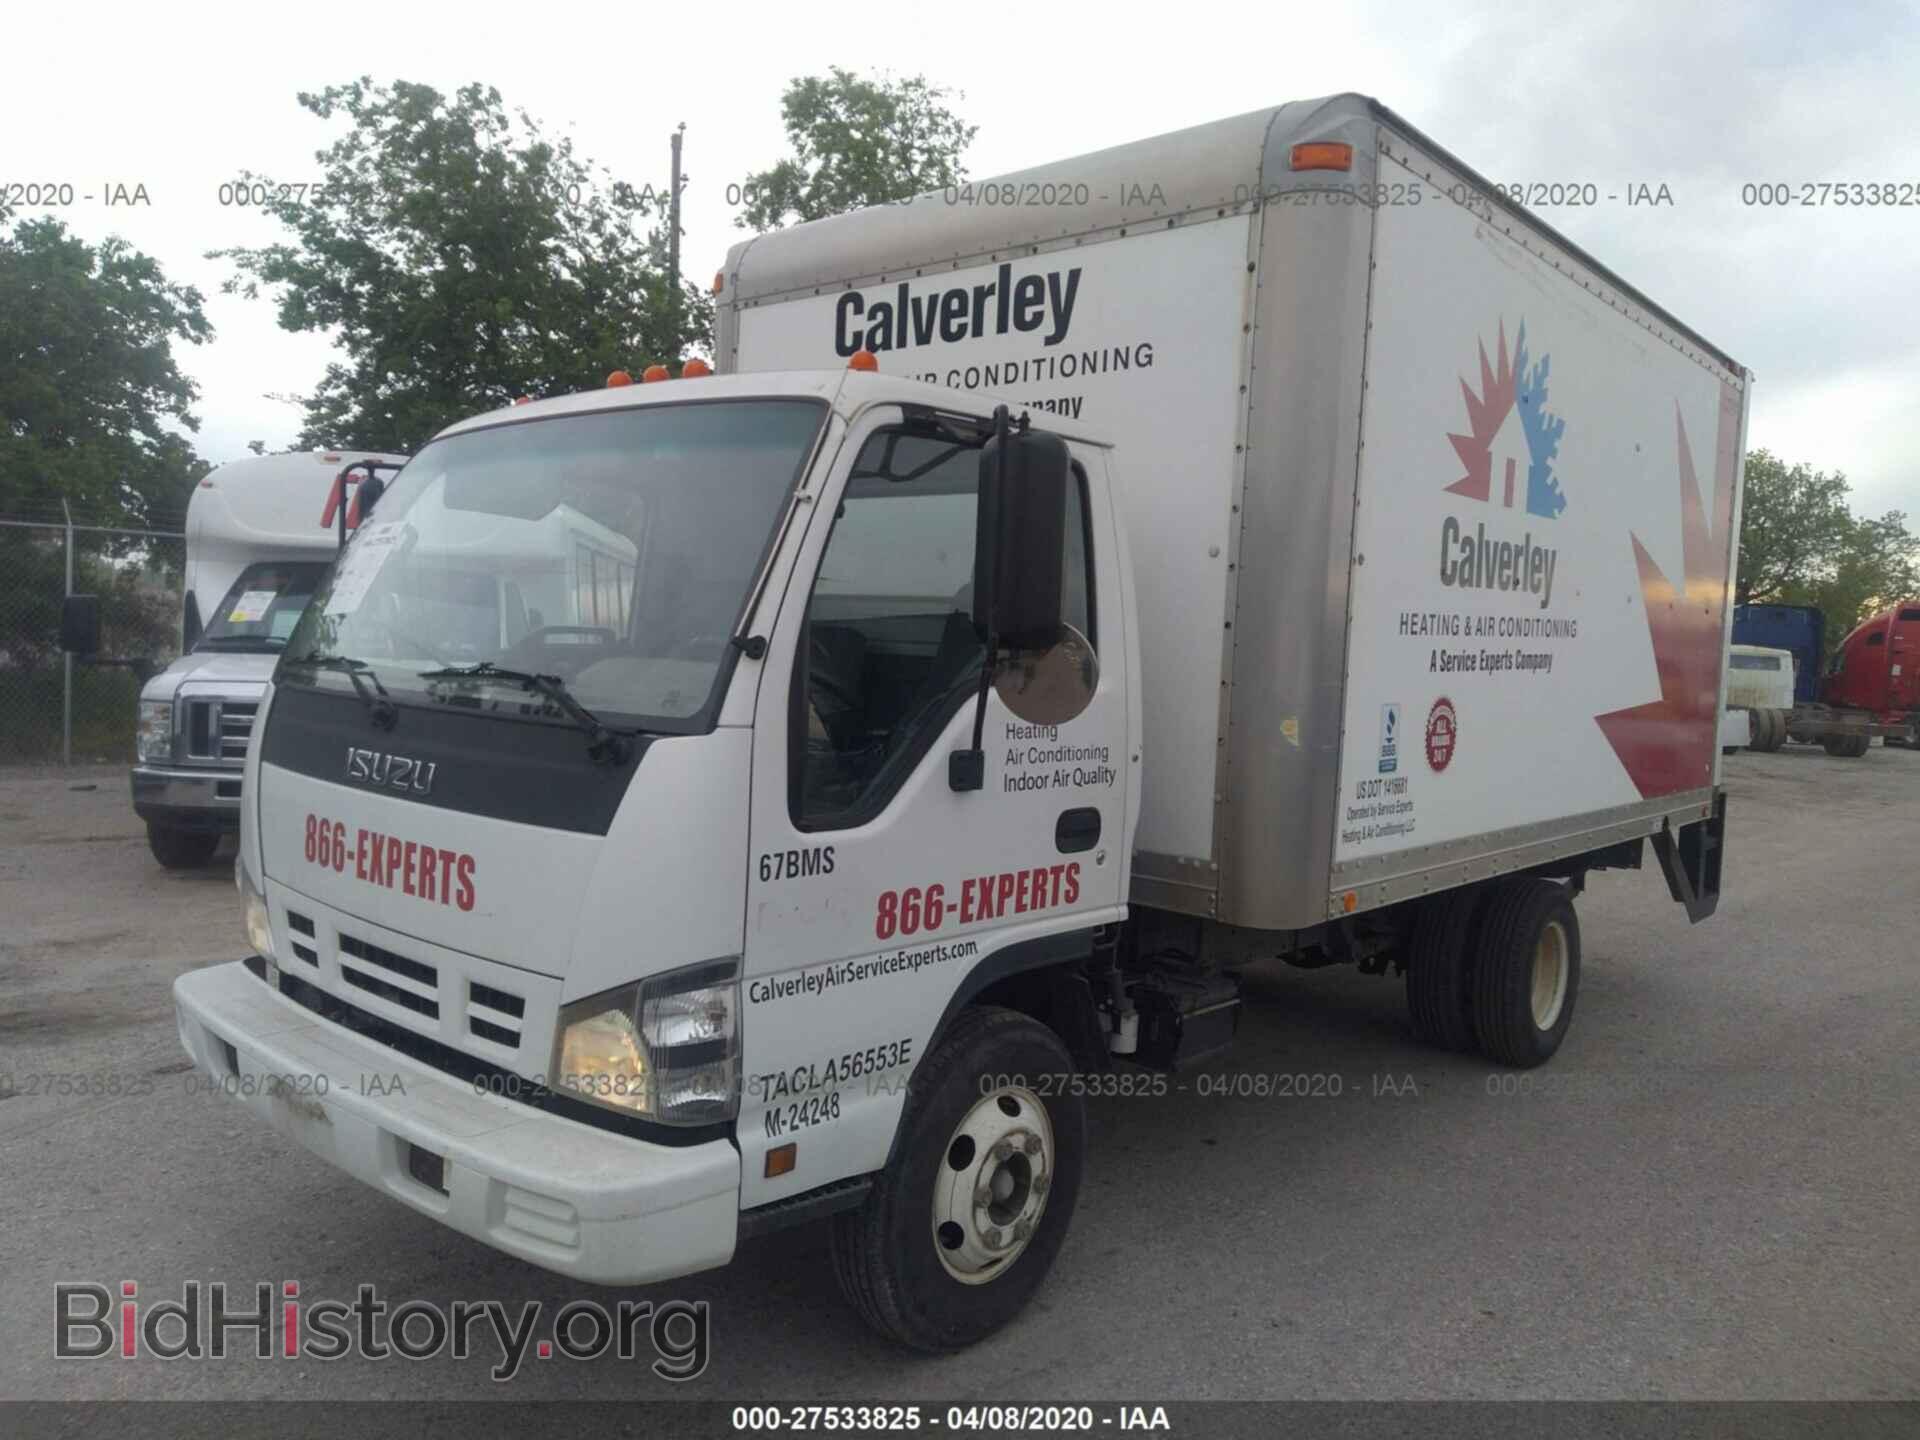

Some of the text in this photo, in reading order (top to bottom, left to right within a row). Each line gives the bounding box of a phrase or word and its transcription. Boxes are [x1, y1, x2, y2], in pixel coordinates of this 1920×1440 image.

[835, 262, 1082, 358] Calverley
[1440, 515, 1557, 609] Calverley
[1400, 612, 1578, 638] HEATING & AIR CONDITIONING
[1429, 649, 1553, 676] A Service Experts Company
[1005, 723, 1059, 742] Heating
[1005, 744, 1109, 766] Air Conditioning
[346, 747, 437, 794] ISUZU
[1004, 765, 1117, 792] Indoor Air Quality
[304, 813, 476, 912] 866-EXPERTS
[759, 846, 835, 882] 67BMS
[876, 862, 1081, 940] 866-EXPERTS
[749, 938, 979, 1005] CalverleyAirServiceExperts.com
[760, 1038, 913, 1103] TACLA56553E
[765, 1092, 840, 1138] M-24248
